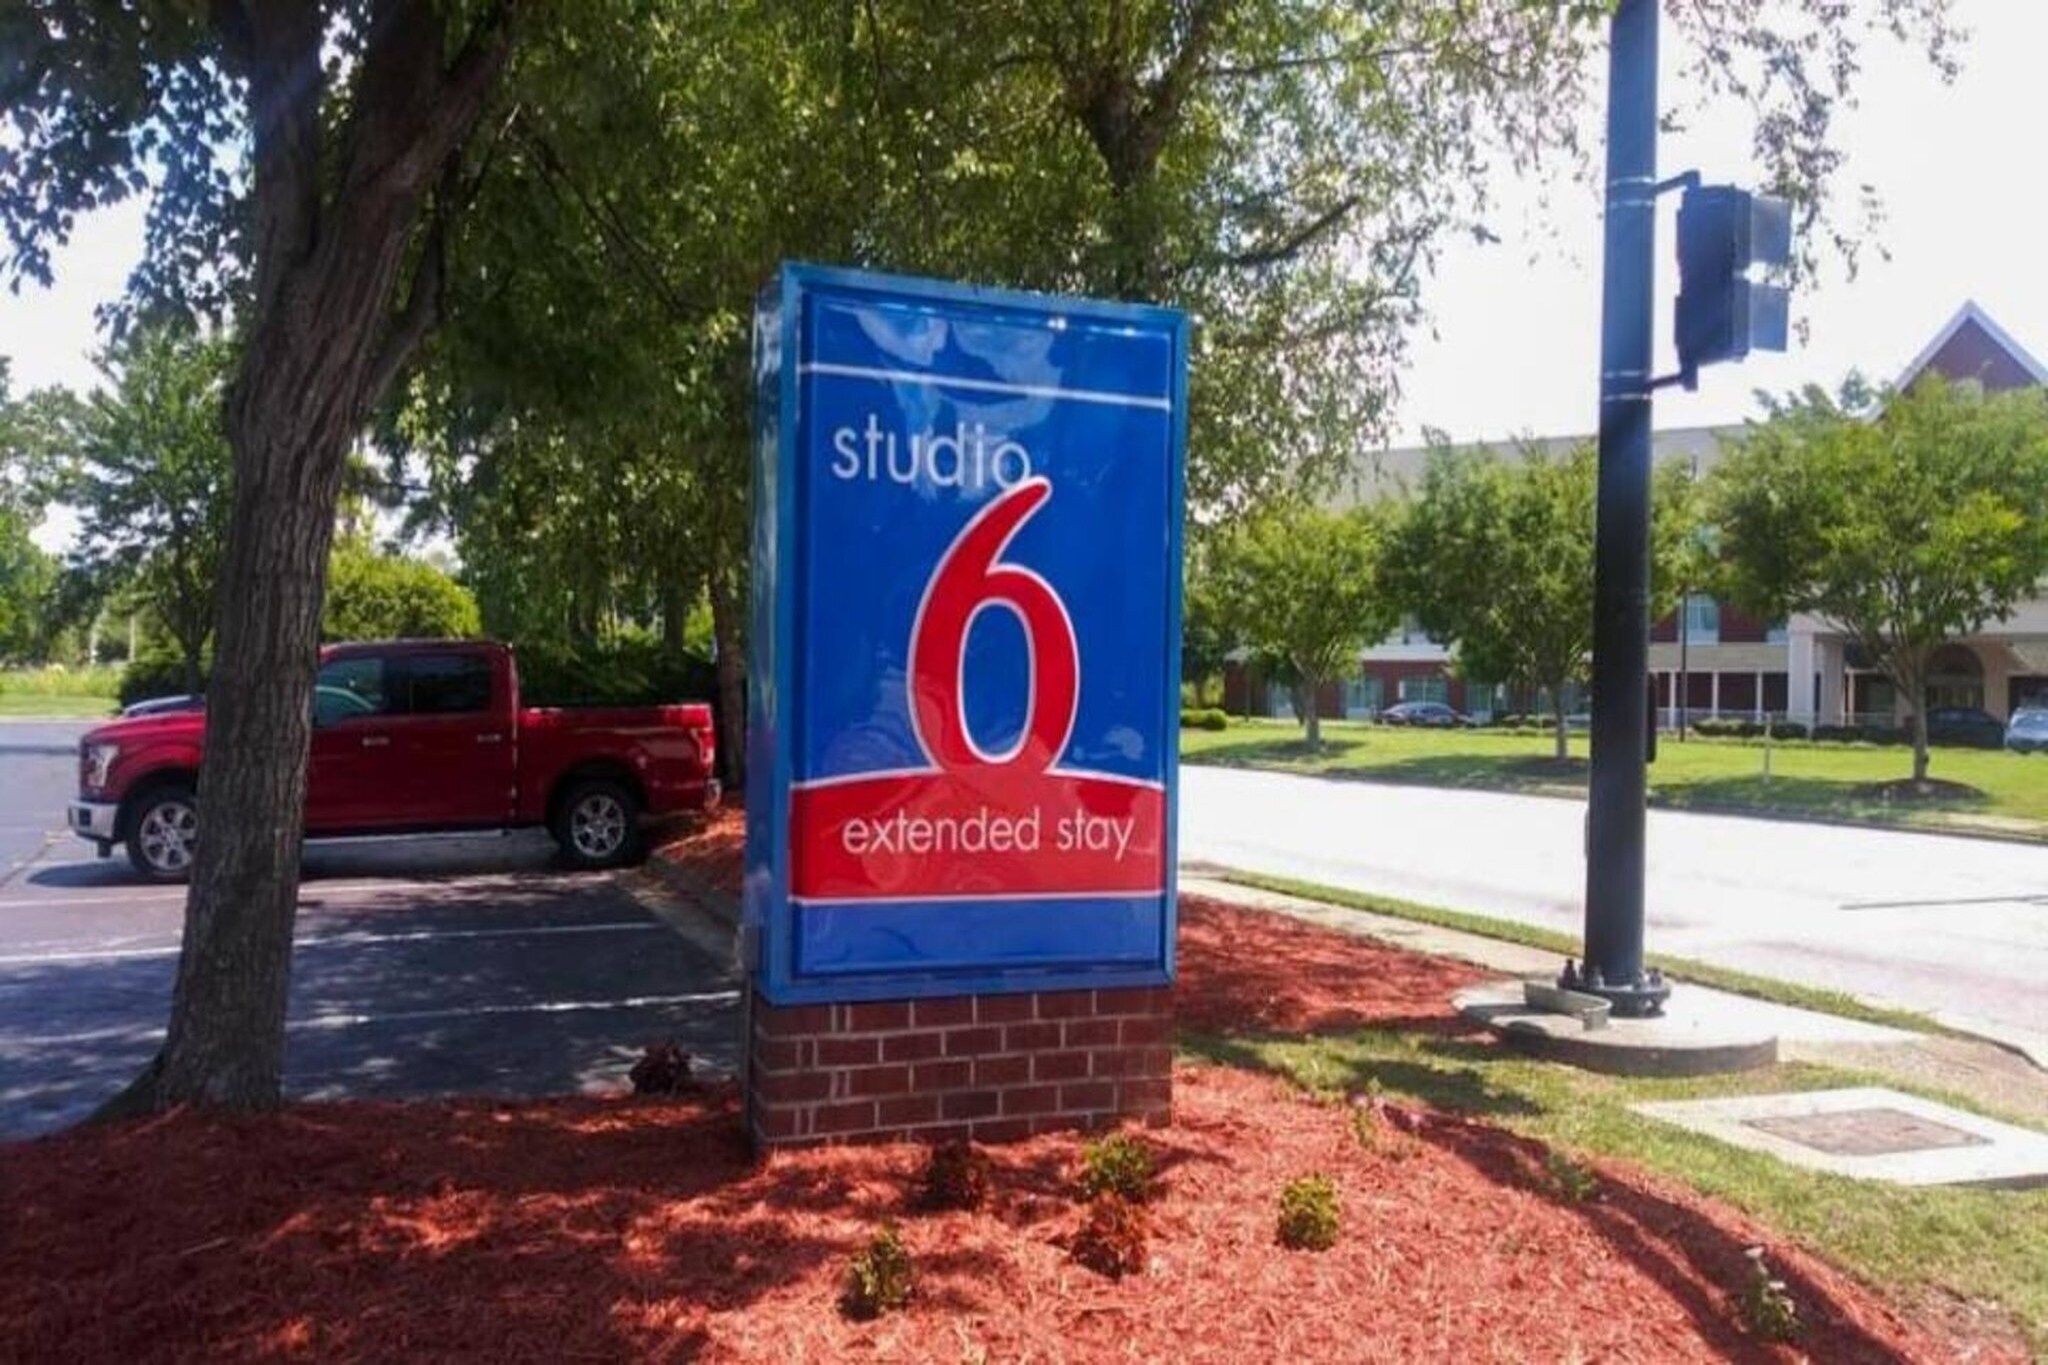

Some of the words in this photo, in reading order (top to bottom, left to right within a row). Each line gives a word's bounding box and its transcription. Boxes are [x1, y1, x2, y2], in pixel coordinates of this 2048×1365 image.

[831, 413, 1030, 488] studio
[906, 476, 1081, 774] 6
[842, 807, 1040, 853] extended
[1056, 809, 1135, 860] stay
